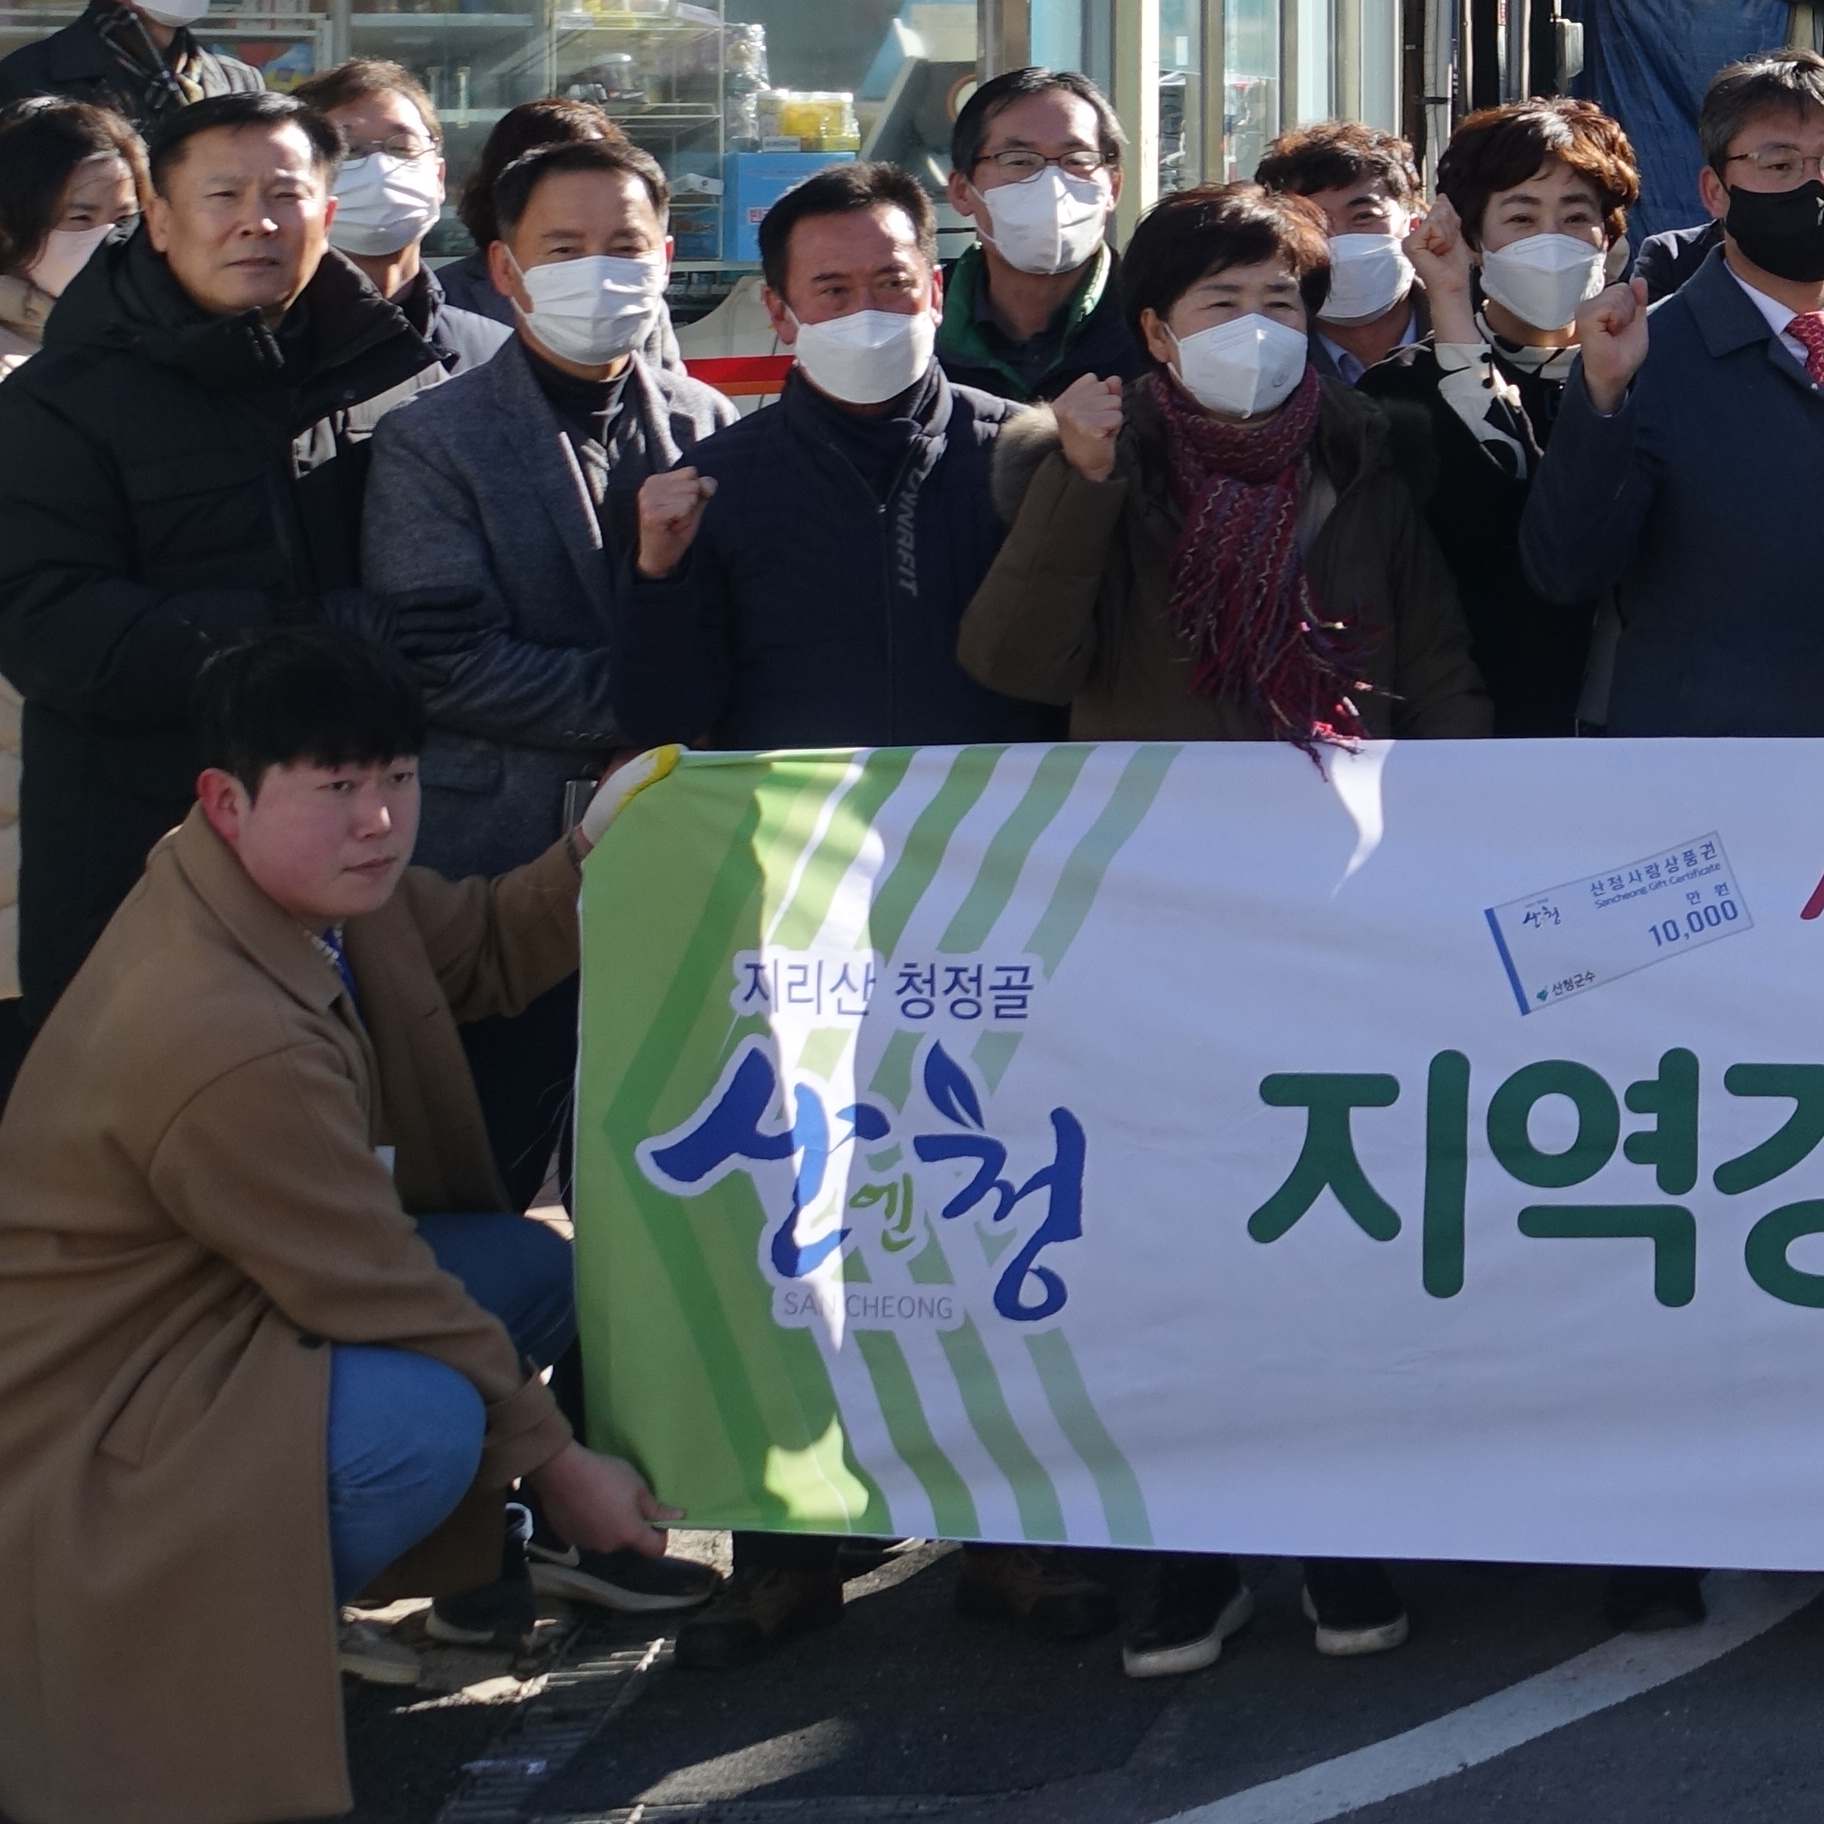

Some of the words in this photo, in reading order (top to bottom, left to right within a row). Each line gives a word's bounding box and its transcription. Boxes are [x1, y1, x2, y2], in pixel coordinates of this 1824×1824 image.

[1589, 840, 1718, 898] 산청사랑상품권
[1669, 862, 1722, 886] Certificate
[1647, 898, 1740, 948] 10,000
[742, 958, 876, 1018] 지리산
[896, 958, 1035, 1020] 청정골
